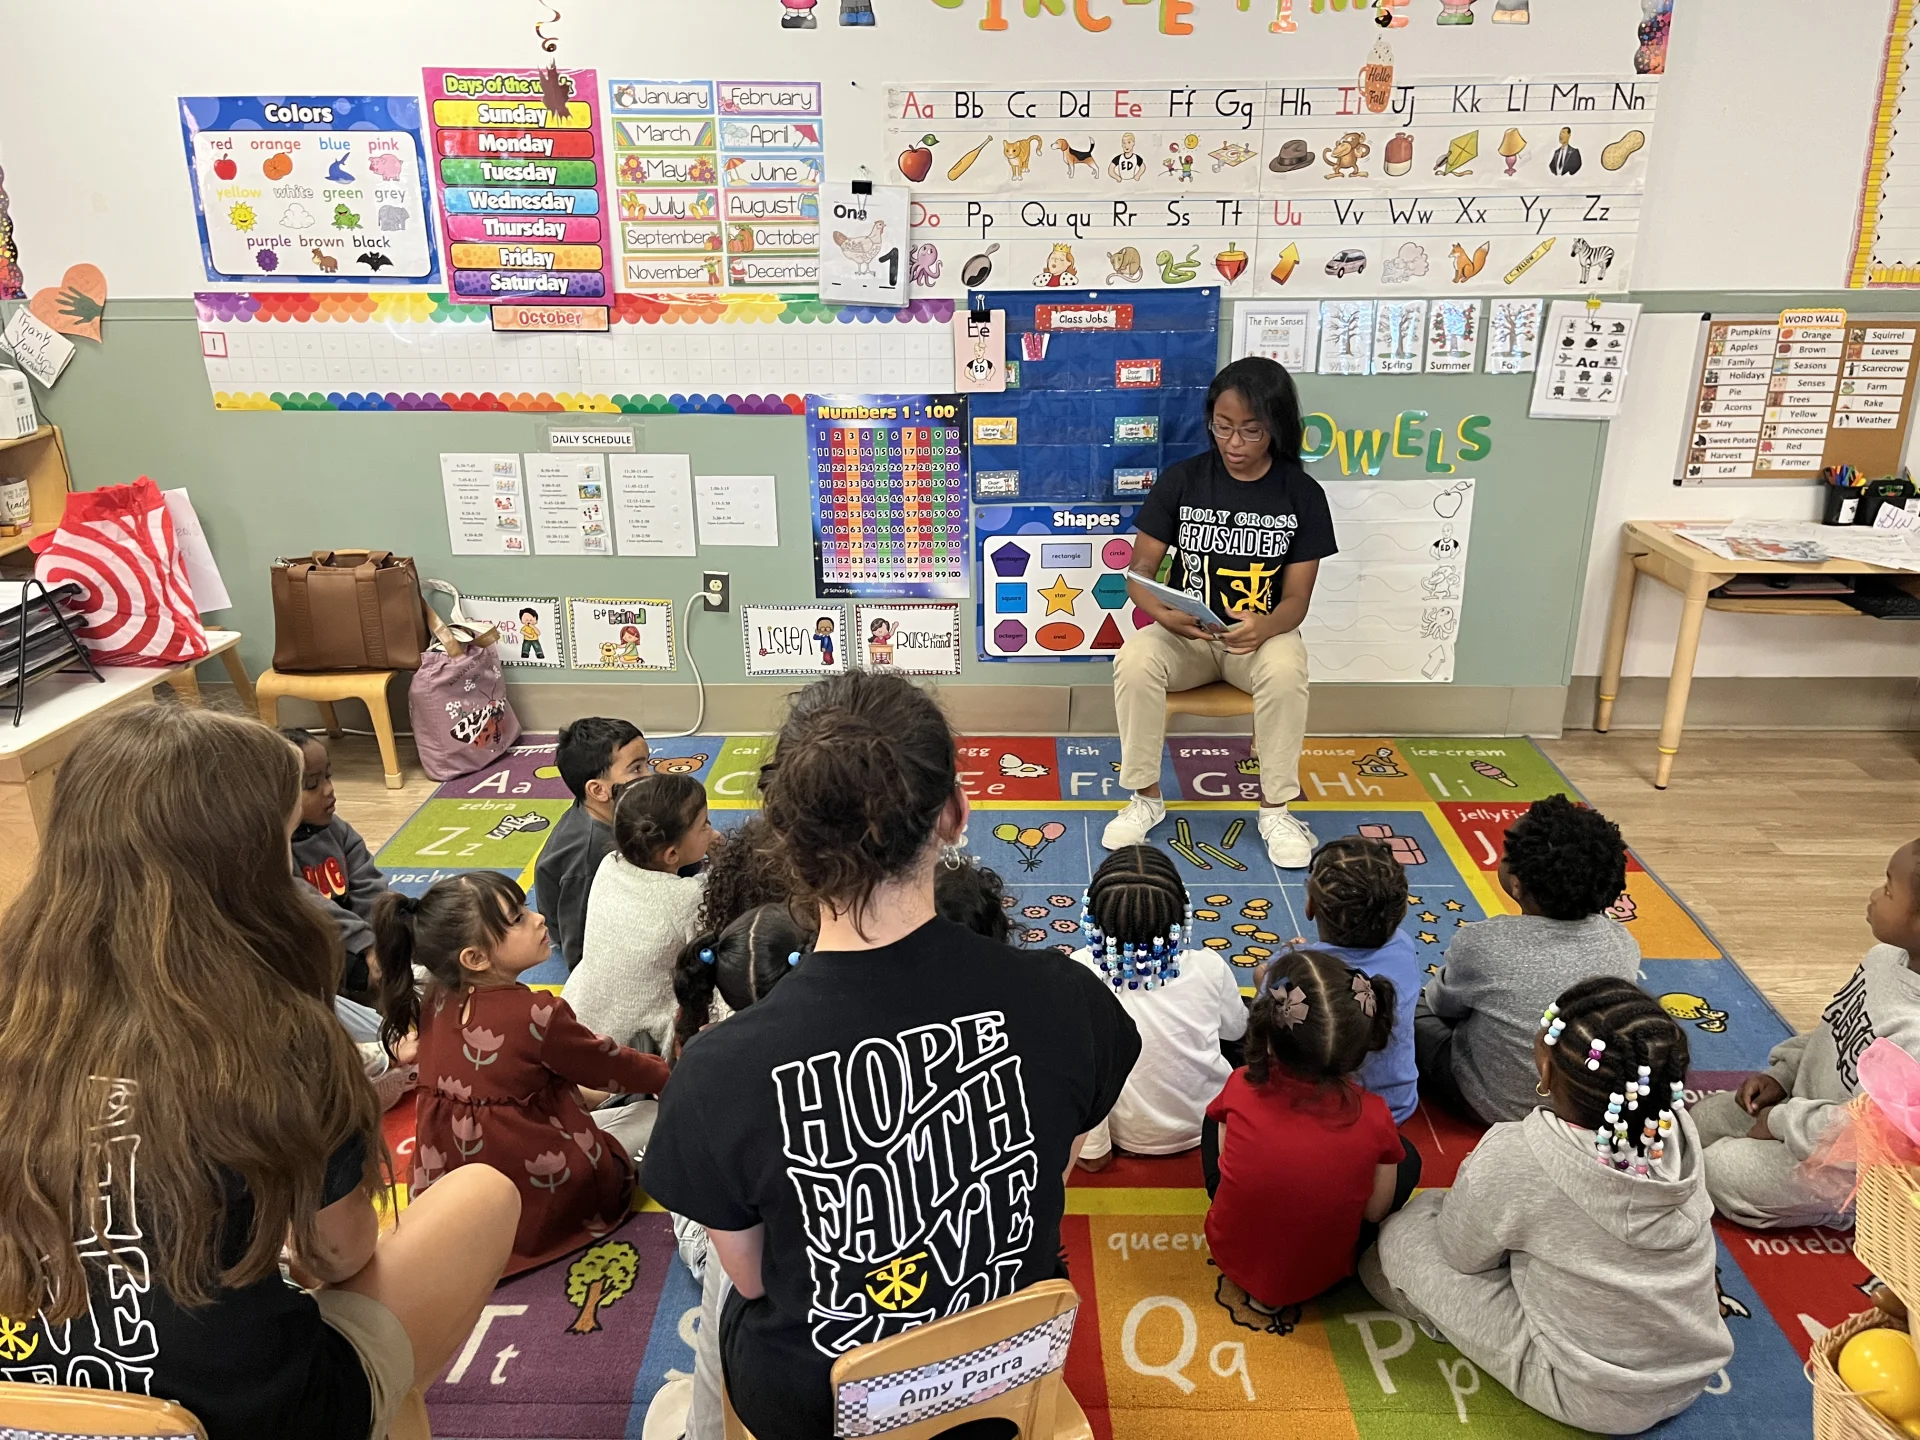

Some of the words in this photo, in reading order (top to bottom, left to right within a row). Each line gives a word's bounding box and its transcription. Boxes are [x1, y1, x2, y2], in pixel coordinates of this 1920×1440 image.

[445, 75, 483, 96] Days
[485, 76, 502, 94] of
[504, 78, 529, 93] the
[1368, 68, 1391, 83] Hello
[639, 88, 708, 109] January
[730, 88, 811, 109] February
[902, 91, 934, 119] Aa
[955, 91, 984, 119] Bb
[1007, 91, 1037, 119] Cc
[1059, 91, 1090, 119] Dd
[1114, 91, 1142, 118] Ee
[1169, 90, 1196, 117] Ff
[1280, 88, 1311, 115] Hh
[1369, 90, 1385, 105] Fall
[1453, 85, 1481, 113] Kk
[1550, 84, 1595, 111] Mm
[1612, 83, 1645, 110] Nn
[264, 104, 333, 124] Colors
[478, 105, 548, 127] Sunday
[1215, 90, 1253, 130] Gg
[636, 125, 690, 142] March
[750, 125, 789, 148] April
[211, 138, 233, 151] red
[251, 139, 301, 154] orange
[320, 138, 350, 150] blue
[369, 139, 399, 153] pink
[478, 133, 554, 156] Monday
[480, 162, 557, 185] Tuesday
[647, 160, 687, 183] May
[751, 163, 797, 181] June
[1121, 161, 1133, 170] ED
[216, 186, 261, 200] yellow
[273, 186, 314, 199] white
[323, 187, 363, 201] green
[375, 187, 405, 202] grey
[467, 190, 575, 212] Wednesday
[648, 197, 685, 218] July
[731, 196, 797, 218] August
[1113, 201, 1137, 226] Rr
[1167, 202, 1189, 227] Ss
[1216, 201, 1243, 226] Tt
[1274, 200, 1301, 226] Uu
[1334, 199, 1364, 225] Vv
[1389, 199, 1434, 224] Ww
[1455, 198, 1486, 224] Xx
[1519, 197, 1551, 235] Yy
[1582, 195, 1609, 222] Zz
[482, 218, 566, 240] Thursday
[968, 202, 993, 239] Pp
[1021, 202, 1057, 227] Qu
[1066, 212, 1091, 239] qu
[247, 236, 291, 249] purple
[300, 235, 344, 247] brown
[353, 235, 390, 248] black
[627, 230, 708, 250] September
[756, 229, 819, 246] October
[500, 248, 554, 269] Friday
[878, 248, 899, 286] 1
[1514, 256, 1535, 274] YELLOW
[629, 265, 703, 280] November
[748, 263, 819, 278] December
[490, 274, 569, 294] Saturday
[519, 310, 582, 326] October
[1059, 314, 1082, 324] Class
[1086, 314, 1108, 324] Jobs
[1249, 318, 1261, 326] The
[1263, 316, 1279, 325] Five
[1280, 316, 1304, 326] Senses
[1785, 316, 1813, 324] WORD
[1816, 315, 1840, 323] WALL
[19, 307, 54, 351] Thank
[1730, 328, 1771, 338] Pumpkins
[1802, 331, 1832, 341] Orange
[1872, 331, 1904, 341] Squirrel
[1730, 343, 1758, 352] Apples
[1799, 346, 1826, 354] Brown
[975, 365, 985, 373] ED
[1381, 360, 1412, 371] Spring
[1430, 360, 1470, 370] Summer
[1576, 357, 1599, 368] Aa
[1728, 358, 1755, 367] Family
[1794, 362, 1827, 370] Seasons
[1862, 364, 1903, 372] Scarecrow
[1729, 371, 1765, 380] Holidays
[1798, 379, 1825, 387] Senses
[1729, 388, 1741, 396] Pie
[1866, 383, 1887, 391] Farm
[818, 406, 896, 419] Numbers
[902, 406, 909, 419] 1
[925, 405, 955, 418] 100
[1724, 403, 1752, 411] Acorns
[1863, 399, 1883, 407] Rake
[1716, 419, 1732, 428] Hay
[1790, 410, 1817, 418] Yellow
[1856, 416, 1891, 425] Weather
[552, 434, 580, 445] DAILY
[582, 434, 631, 445] SCHEDULE
[1733, 436, 1756, 444] Potato
[1782, 427, 1823, 435] Pinecones
[1786, 442, 1802, 450] Red
[1719, 466, 1736, 474] Leaf
[1781, 458, 1810, 467] Farmer
[1053, 511, 1120, 529] Shapes
[1180, 506, 1230, 524] HOLY
[1235, 512, 1298, 528] CROSS
[1179, 522, 1295, 557] CRUSADERS
[594, 609, 606, 620] Be
[608, 608, 647, 625] kind
[758, 626, 813, 655] Listen
[733, 745, 761, 756] cat
[957, 747, 991, 757] egg
[1067, 746, 1100, 756] fish
[1179, 748, 1230, 758] grass
[1411, 747, 1506, 757] ice-cream
[467, 769, 532, 795] Aa
[1070, 772, 1114, 796] Ff
[1192, 772, 1260, 799] Gg
[1310, 772, 1385, 797] Hh
[457, 800, 517, 811] zebra
[415, 827, 484, 856] Zz
[771, 1010, 1009, 1169] HOPE
[786, 1056, 1035, 1264] FAITH
[1121, 1296, 1257, 1402] Qq
[1344, 1311, 1482, 1423] Pp
[899, 1381, 953, 1407] Amy
[961, 1354, 1023, 1389] Parra
